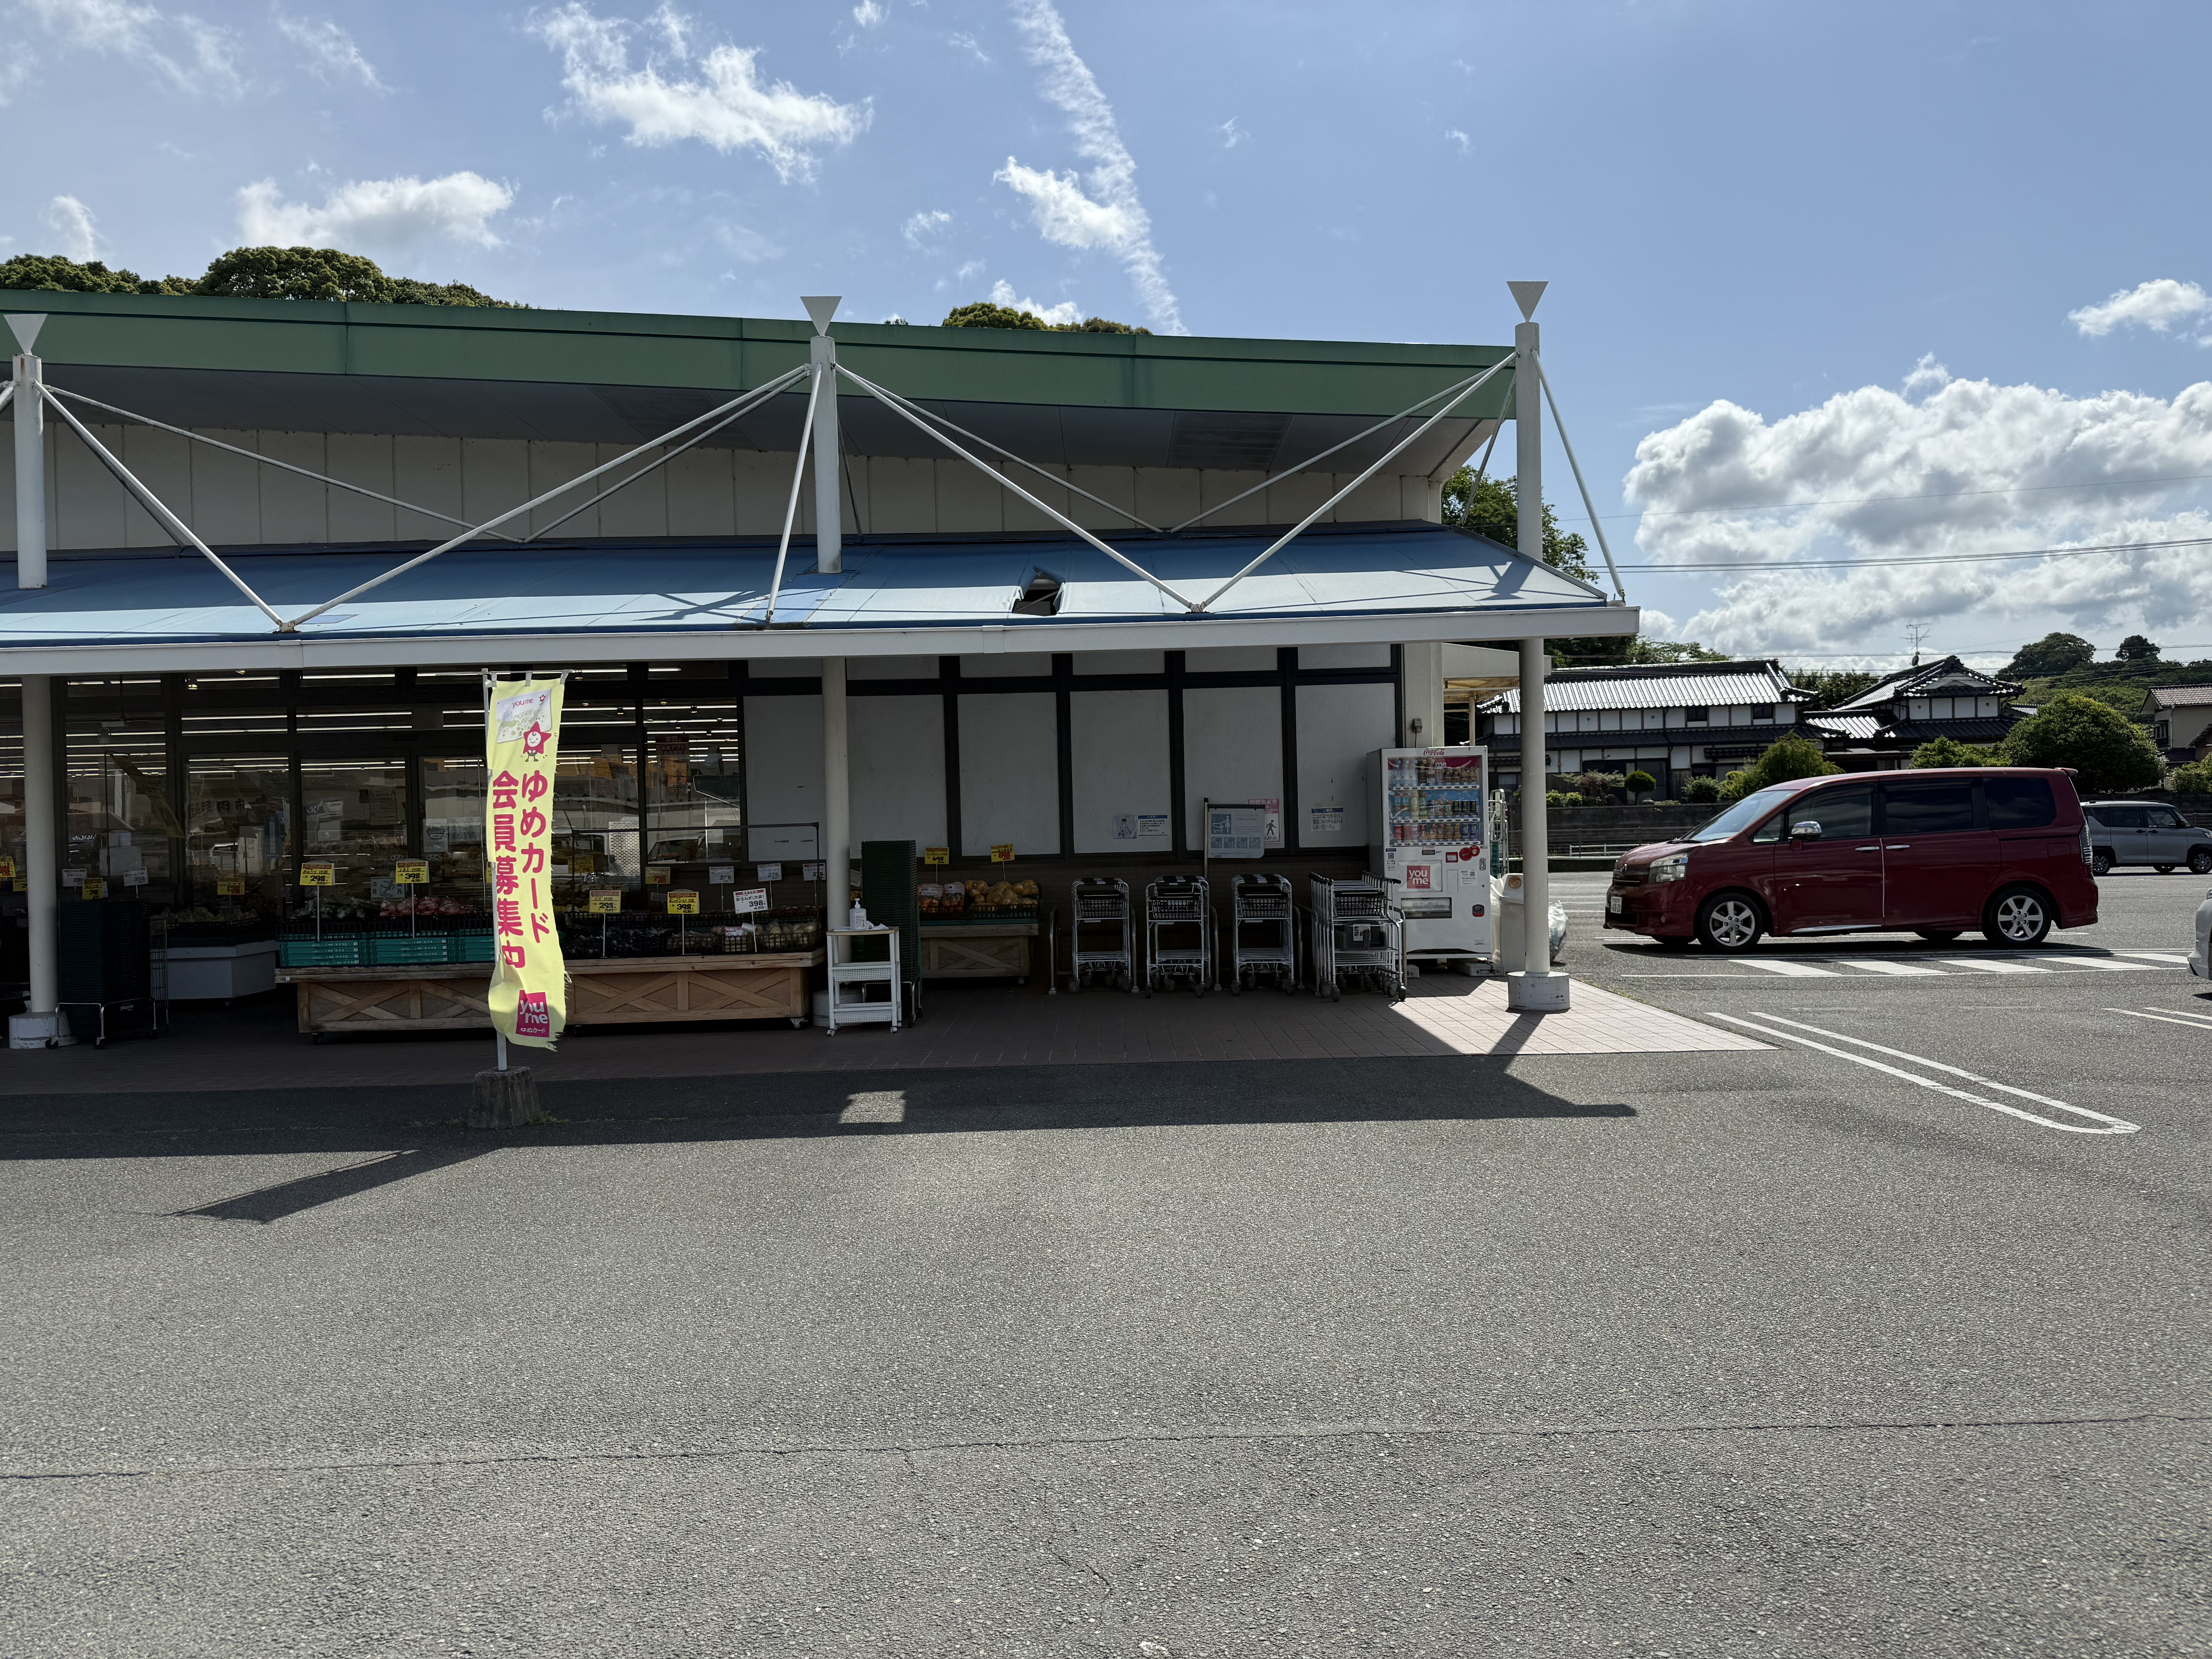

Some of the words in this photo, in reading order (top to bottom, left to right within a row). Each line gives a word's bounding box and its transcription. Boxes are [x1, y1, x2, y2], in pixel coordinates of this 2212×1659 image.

[493, 770, 526, 968] 会員募集中
[520, 770, 550, 943] ゆめカード
[1408, 870, 1427, 879] you
